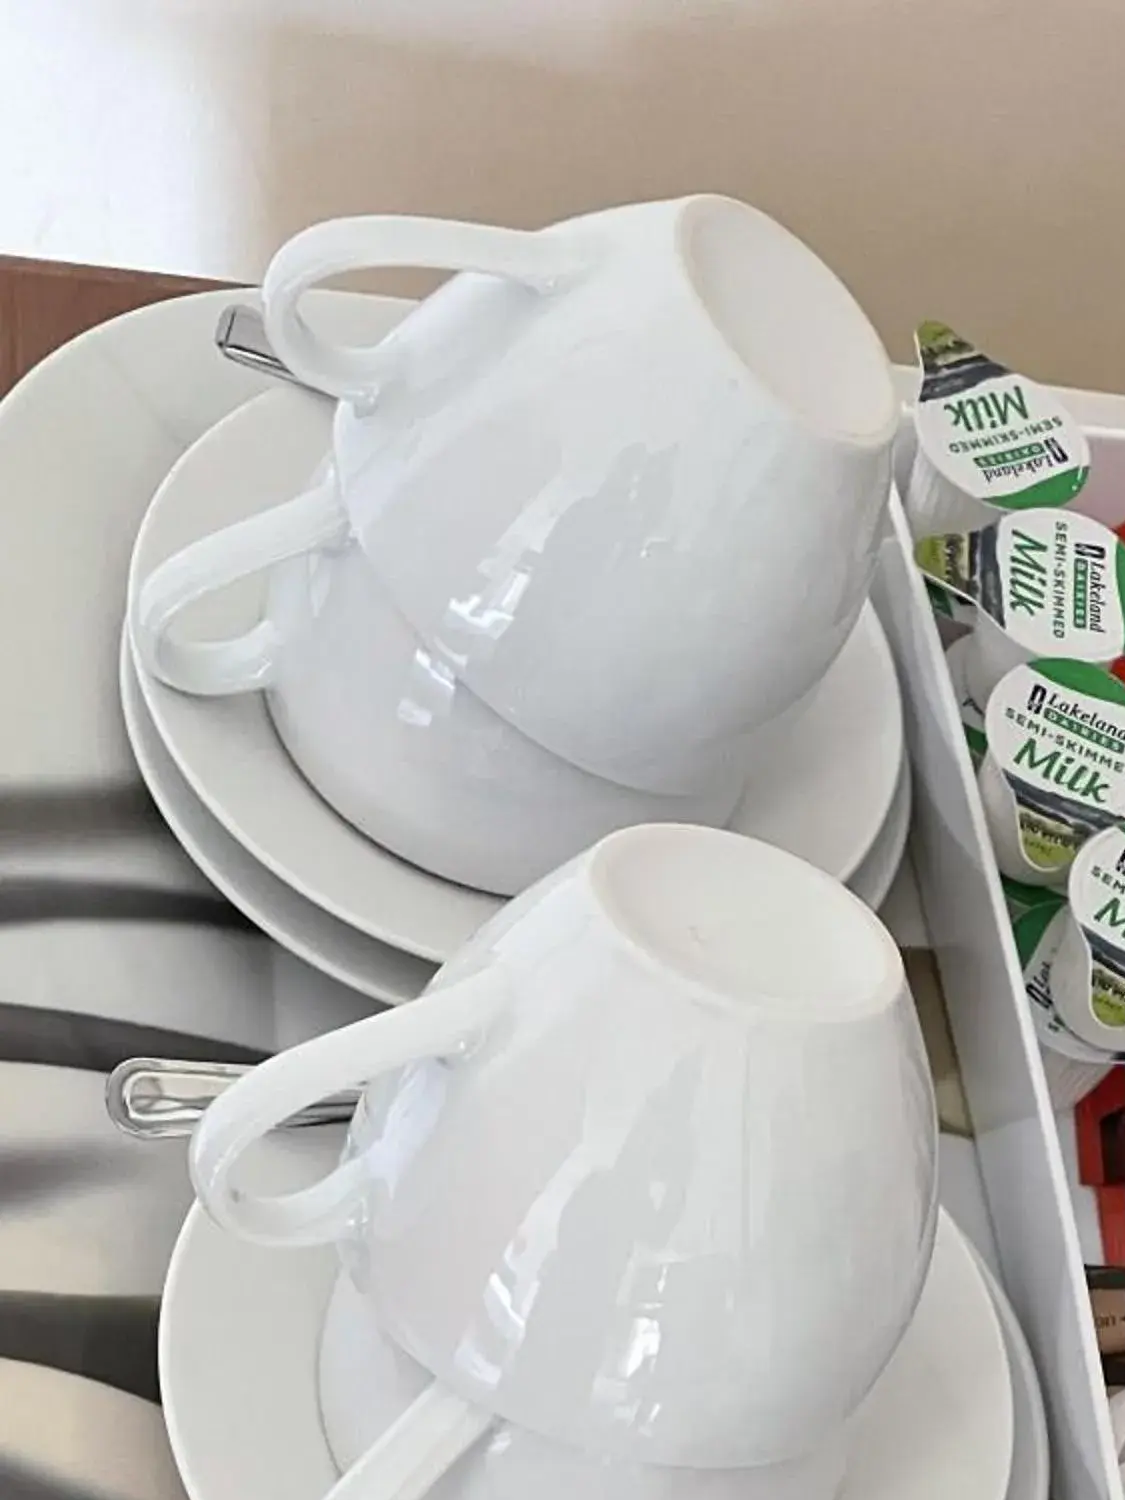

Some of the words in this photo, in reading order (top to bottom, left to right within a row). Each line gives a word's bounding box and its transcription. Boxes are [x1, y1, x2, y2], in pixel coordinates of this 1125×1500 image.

[943, 385, 1030, 432] Milk
[948, 415, 1064, 454] SEMI-SKIMMED
[983, 453, 1062, 483] Lakeland
[1010, 529, 1048, 617] Milk
[1053, 521, 1069, 639] SEMI-SKIMMED
[1088, 559, 1107, 634] Lakeland
[1012, 738, 1112, 804] Milk
